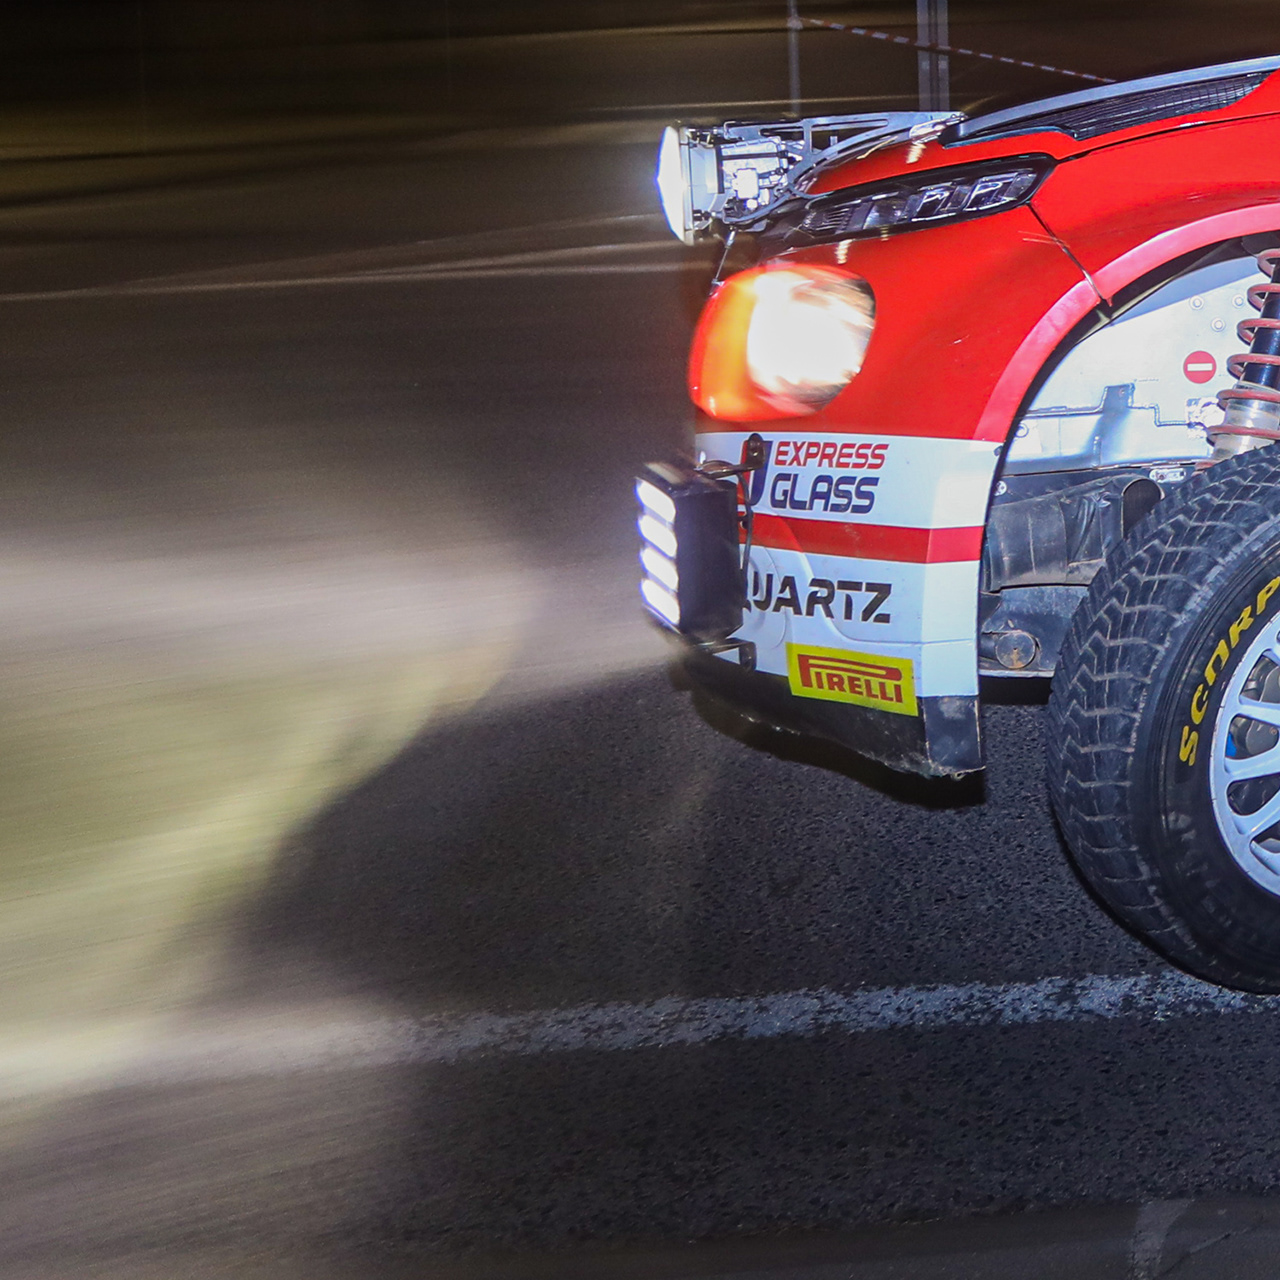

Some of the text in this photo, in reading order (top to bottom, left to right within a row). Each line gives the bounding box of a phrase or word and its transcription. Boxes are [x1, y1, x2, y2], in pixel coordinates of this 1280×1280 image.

[773, 440, 890, 471] EXPRESS
[769, 471, 880, 514] GLASS
[743, 570, 893, 625] UARTZ
[796, 653, 903, 704] PIRELLI
